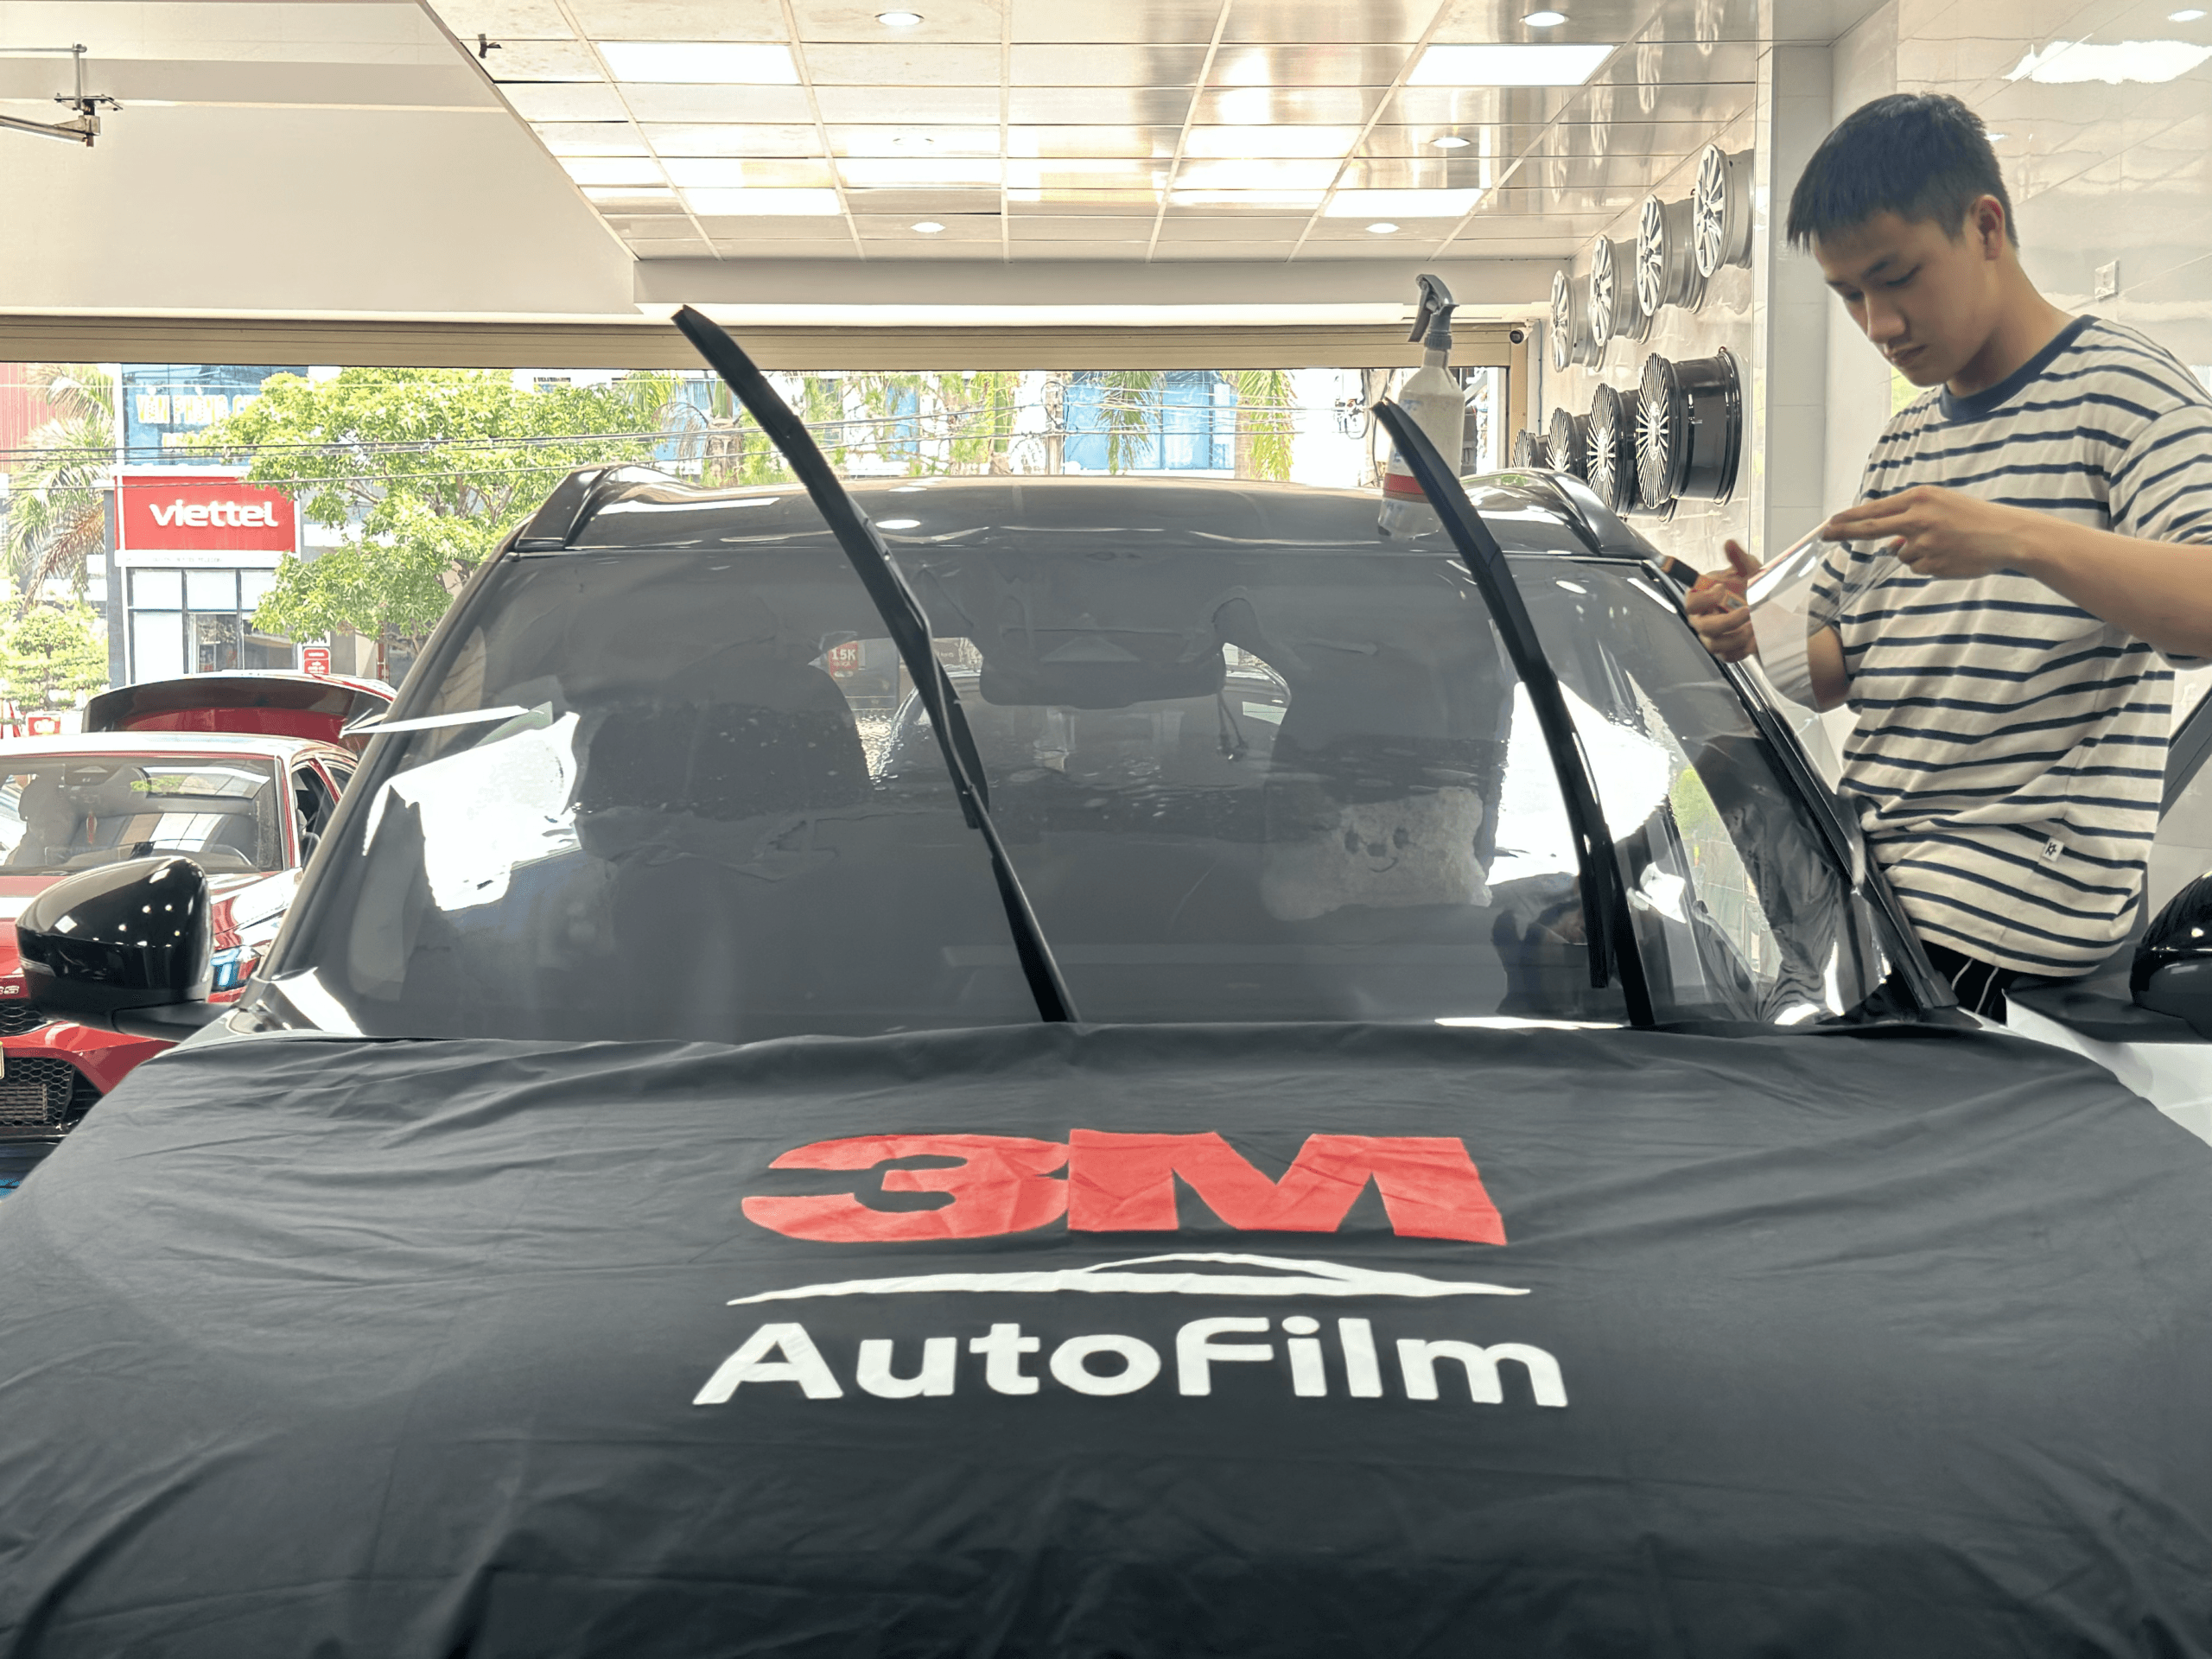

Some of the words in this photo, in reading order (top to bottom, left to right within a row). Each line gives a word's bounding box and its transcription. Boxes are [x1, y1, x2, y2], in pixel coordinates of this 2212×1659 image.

[149, 499, 278, 526] viettel
[831, 649, 856, 661] 15K
[744, 1129, 1506, 1245] 3M
[693, 1316, 1567, 1407] AutoFilm
